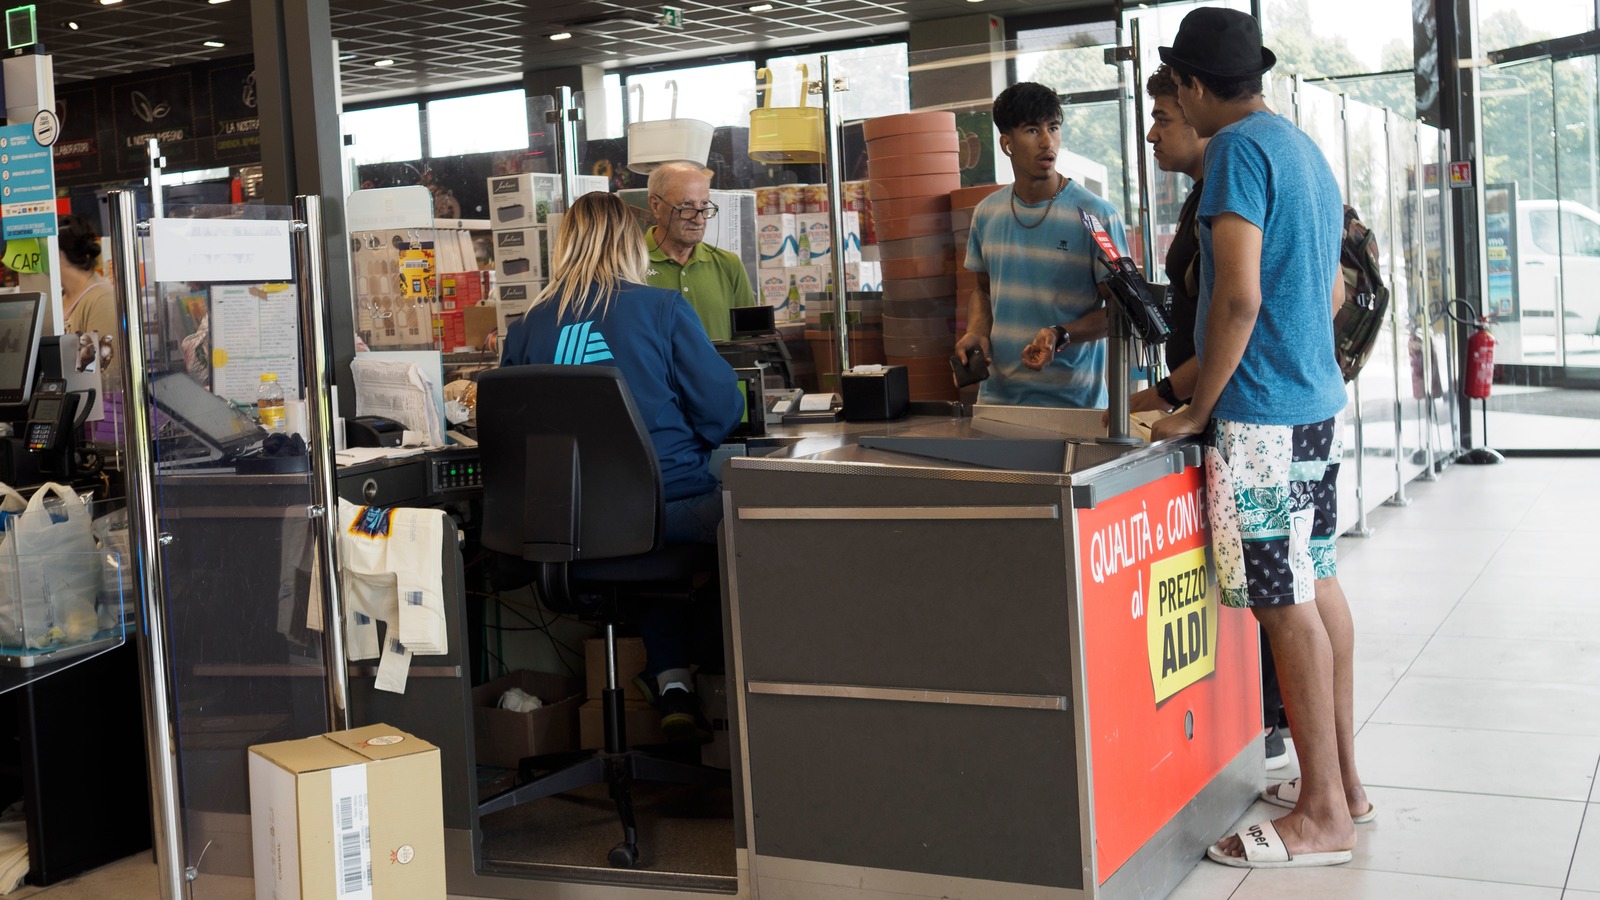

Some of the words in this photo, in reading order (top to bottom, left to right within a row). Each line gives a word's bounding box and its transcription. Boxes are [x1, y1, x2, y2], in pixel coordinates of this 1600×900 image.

[225, 121, 236, 134] LA
[758, 232, 782, 240] PERONI
[1090, 500, 1153, 584] QUALITÀ
[1155, 526, 1164, 551] e
[1131, 569, 1144, 620] al
[1158, 564, 1207, 617] PREZZO
[1162, 606, 1208, 679] ALDI
